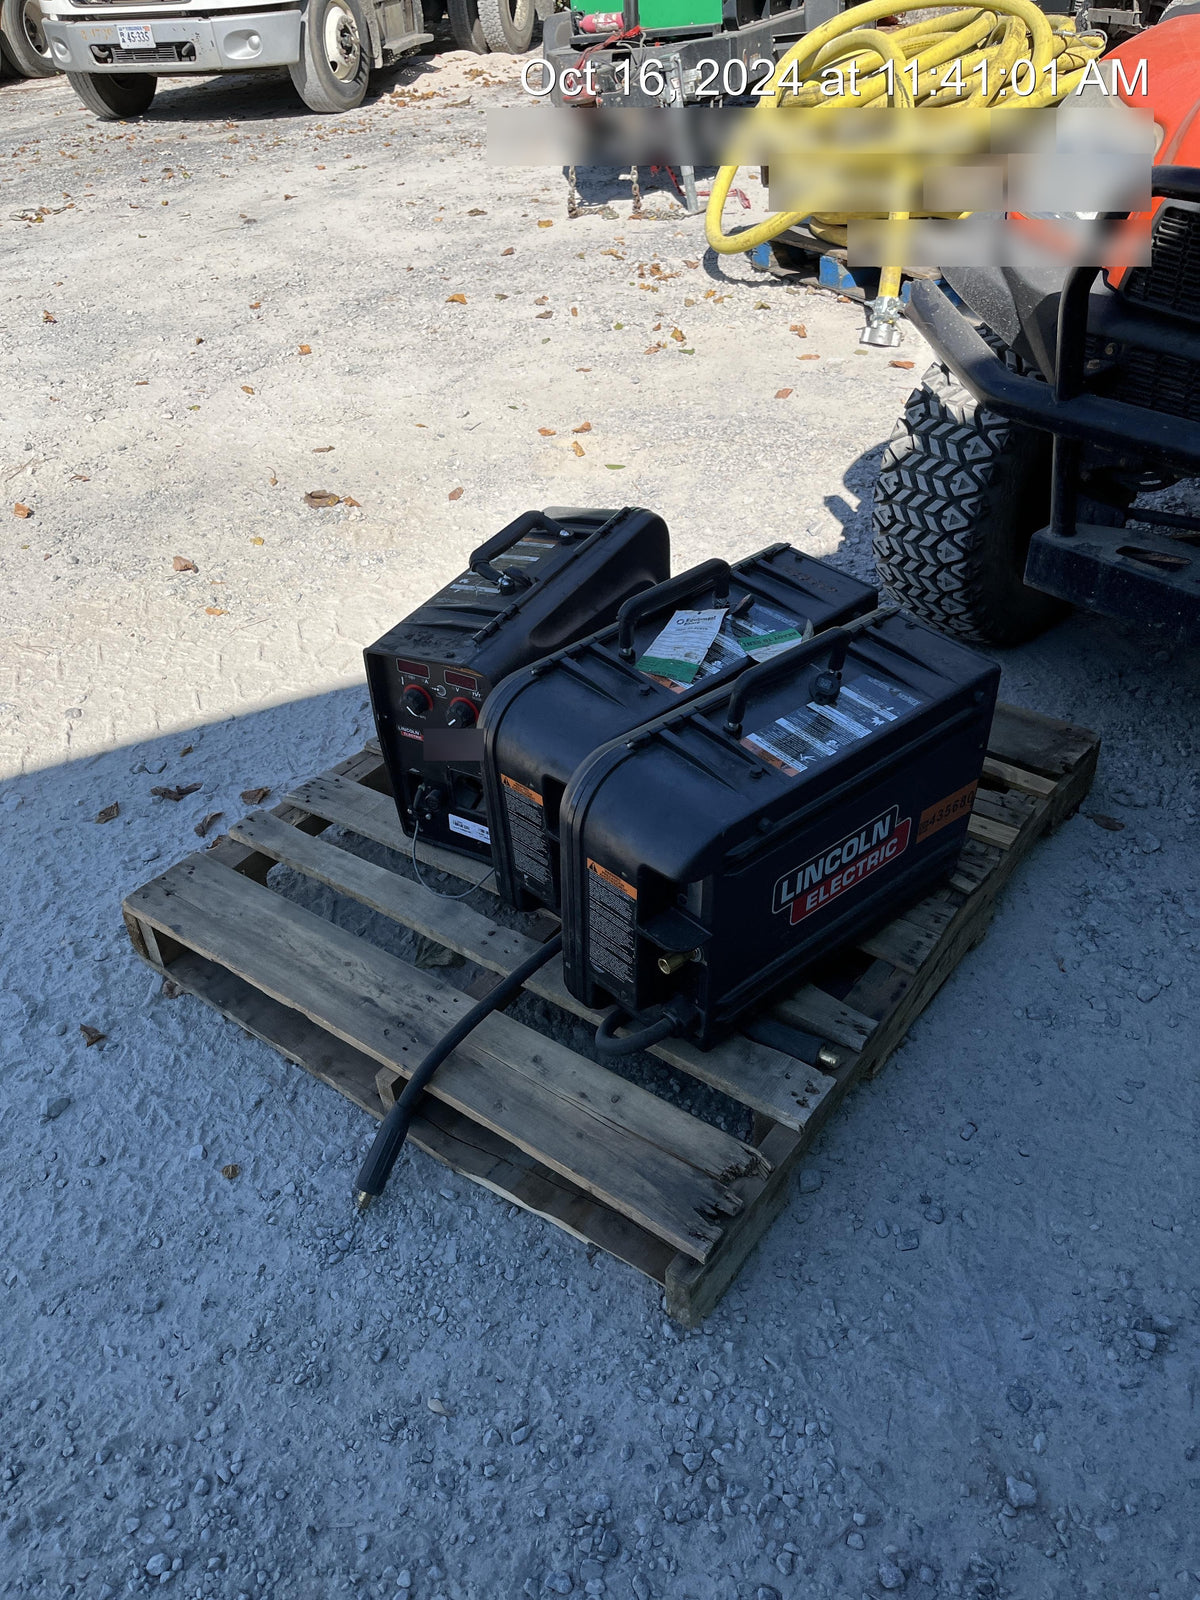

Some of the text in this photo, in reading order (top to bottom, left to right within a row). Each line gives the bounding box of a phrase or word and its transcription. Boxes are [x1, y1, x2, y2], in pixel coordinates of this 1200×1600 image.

[127, 31, 150, 43] 45-335
[780, 814, 892, 905] LINCOLN
[805, 836, 899, 912] ELECTRIC
